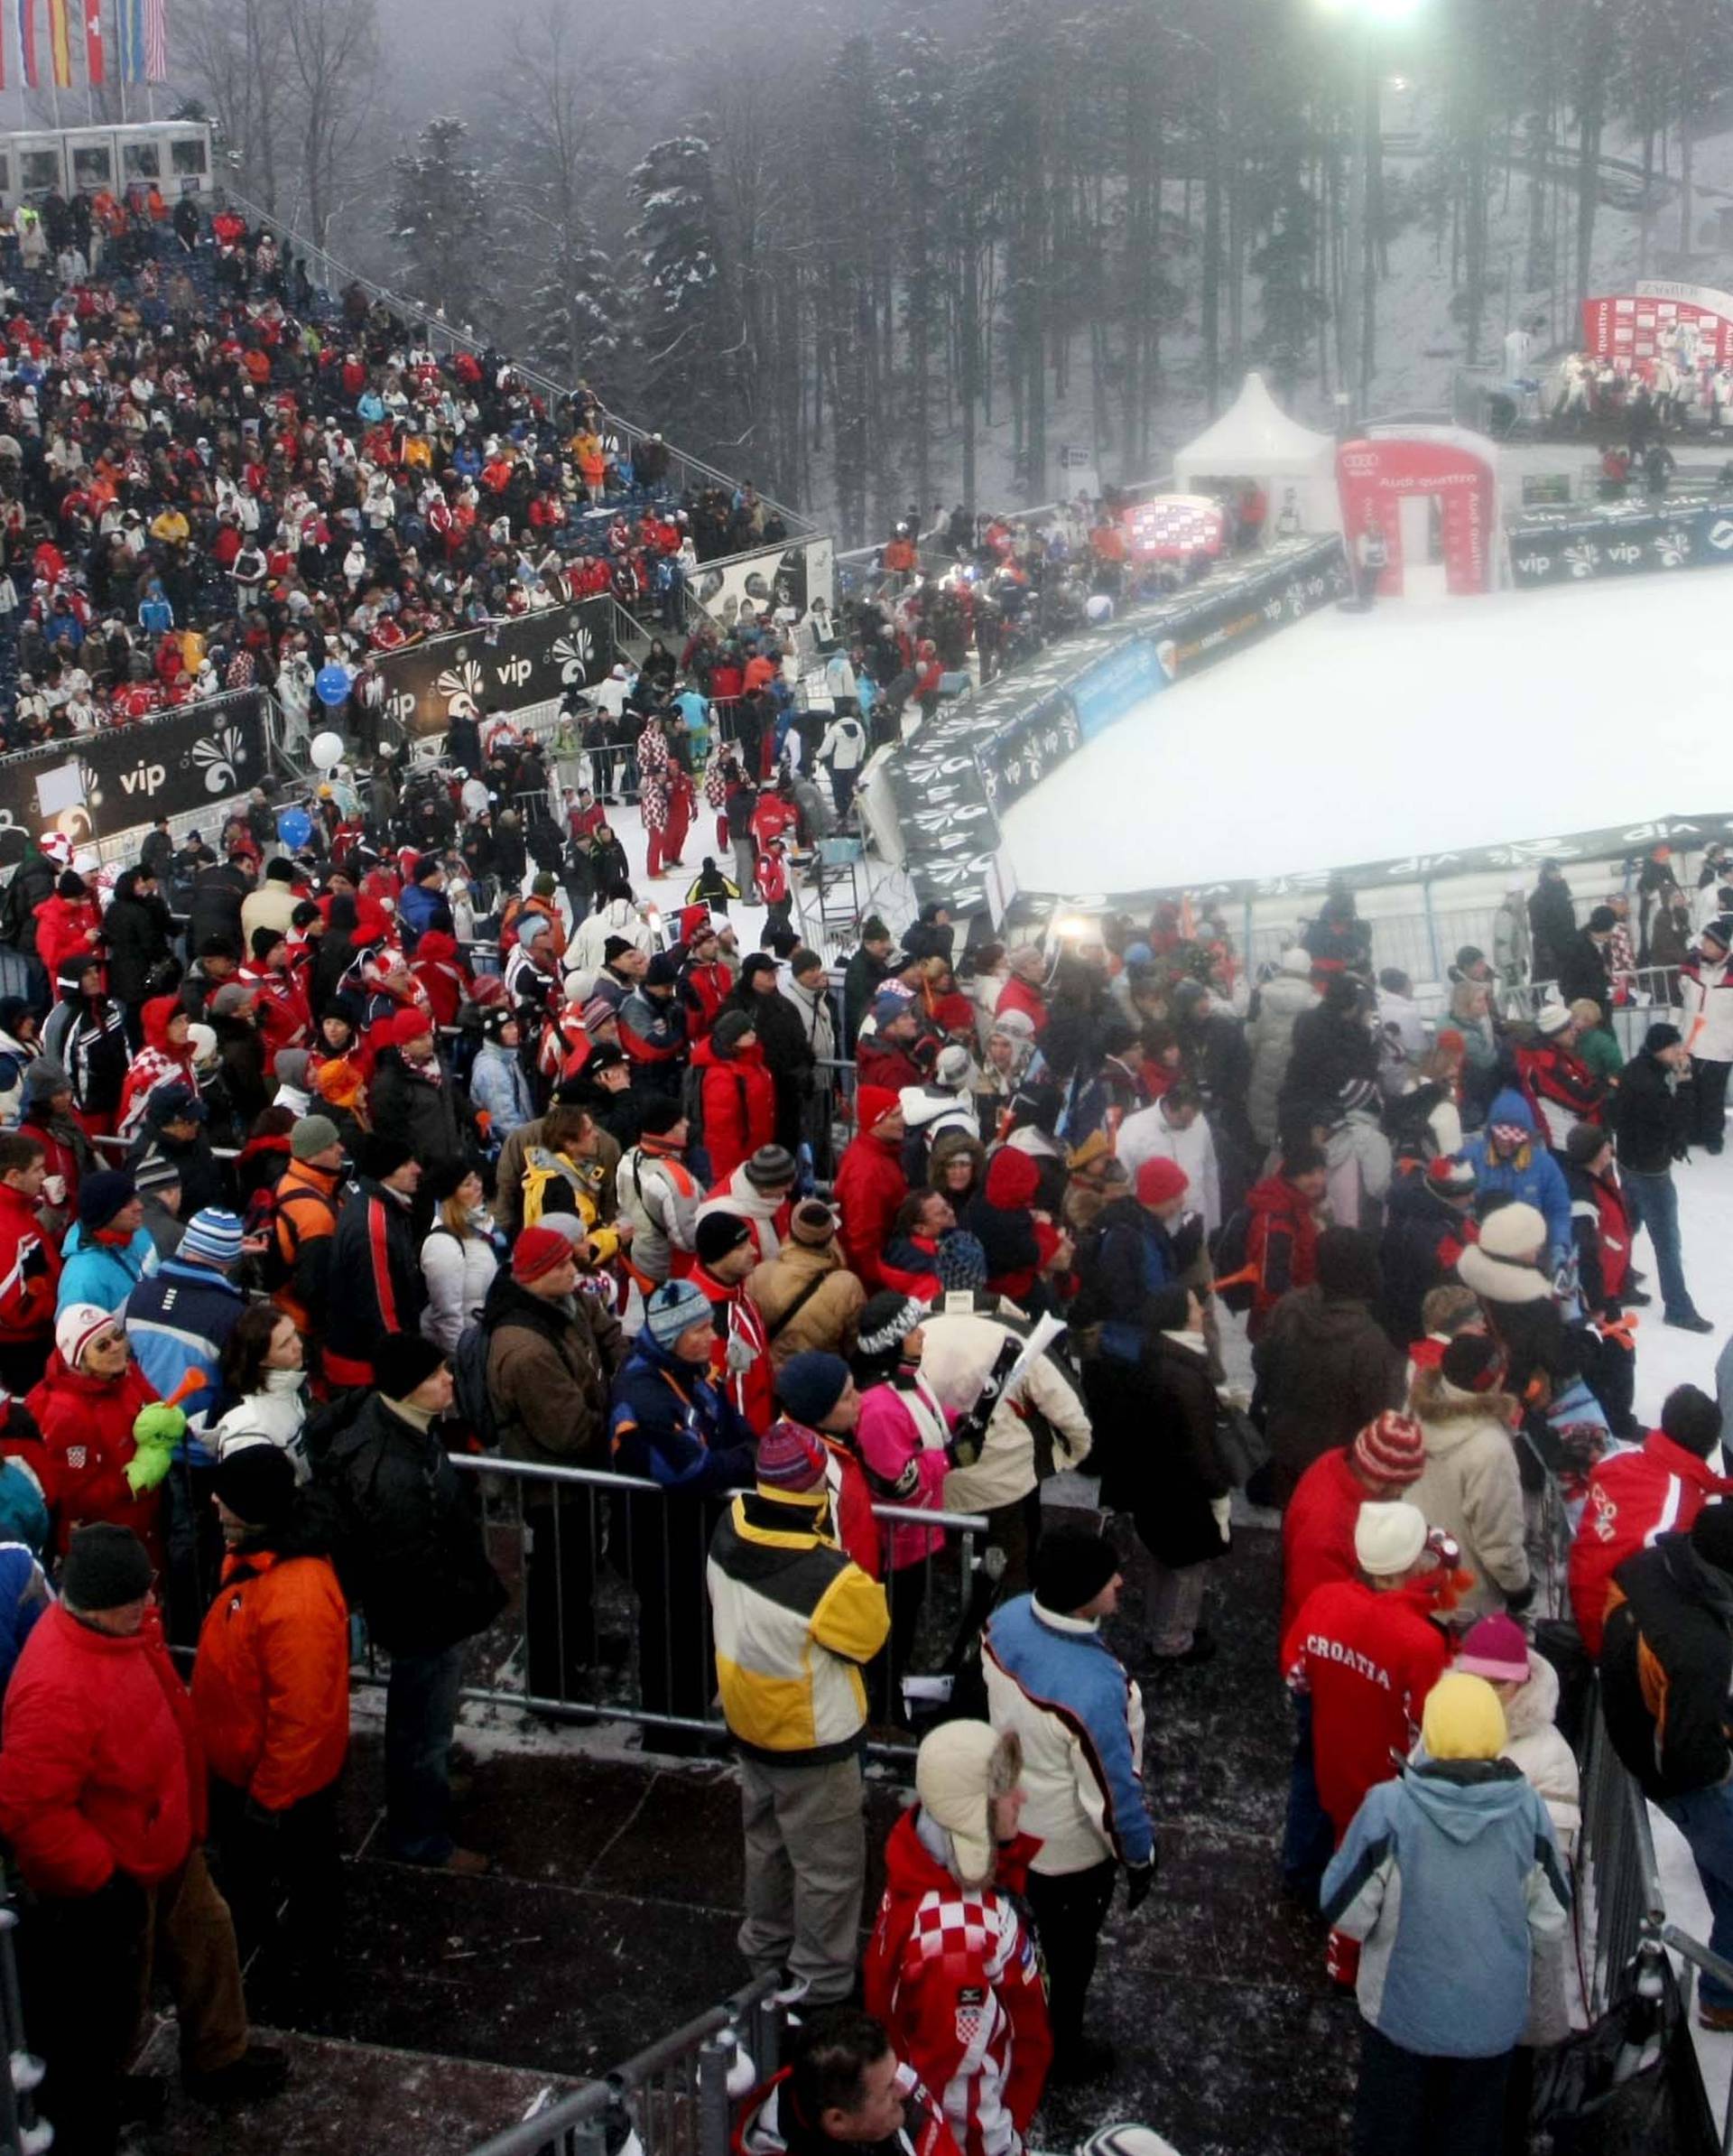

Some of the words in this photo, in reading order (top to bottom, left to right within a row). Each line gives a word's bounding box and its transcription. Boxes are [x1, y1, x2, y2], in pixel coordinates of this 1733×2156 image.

[1518, 552, 1551, 575] vip
[1608, 542, 1641, 564] vip
[496, 655, 533, 687] vip
[119, 759, 166, 796] vip
[1307, 1634, 1391, 1690] CROATIA
